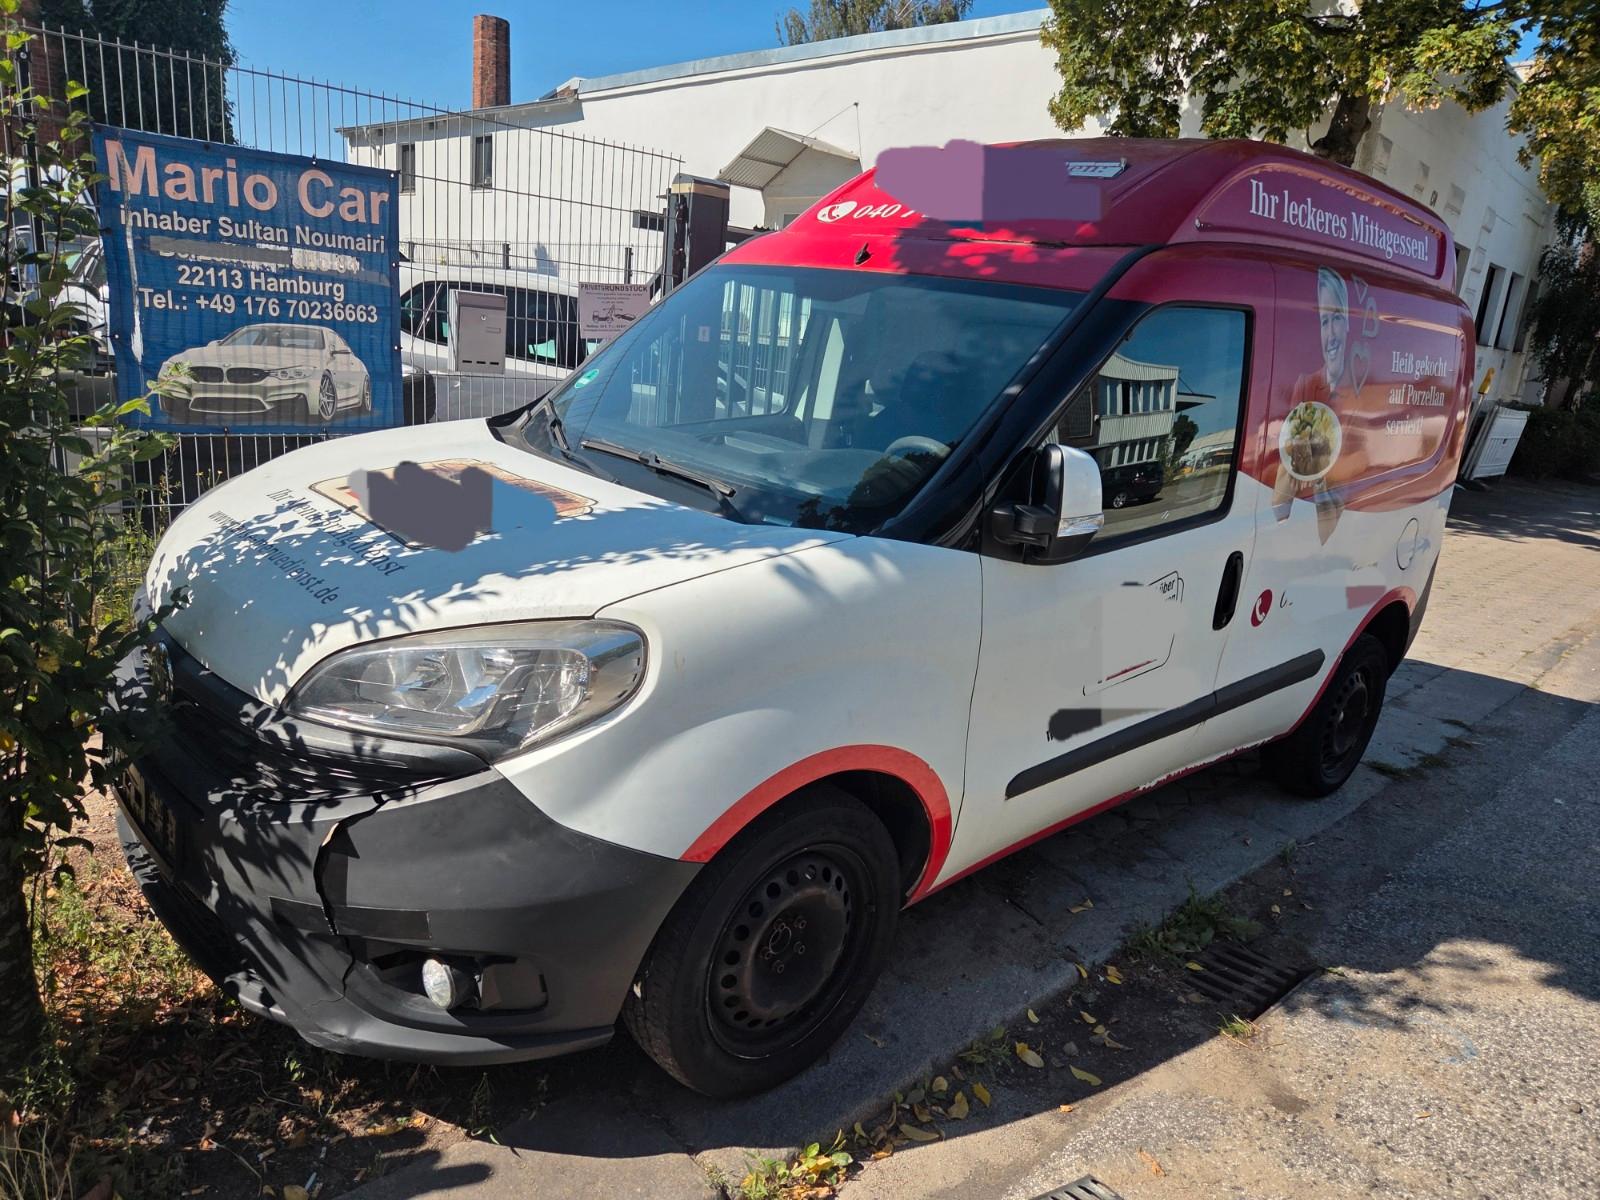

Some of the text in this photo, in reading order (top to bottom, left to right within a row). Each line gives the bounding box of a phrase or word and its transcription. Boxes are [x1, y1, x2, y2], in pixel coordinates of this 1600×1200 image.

[104, 139, 390, 225] Mario Car
[853, 204, 902, 219] 040
[1250, 179, 1429, 262] Ihr leckeres Mittagessen!
[218, 217, 289, 243] Sultan
[295, 225, 386, 254] Noumairi
[177, 265, 345, 301] 22113 Hamburg
[138, 288, 378, 323] Tel.: +49 176 70236663
[1391, 351, 1414, 374] Heiß
[1414, 356, 1447, 380] gekocht
[1388, 384, 1445, 406] auf Porzellan
[266, 488, 294, 501] Ihr
